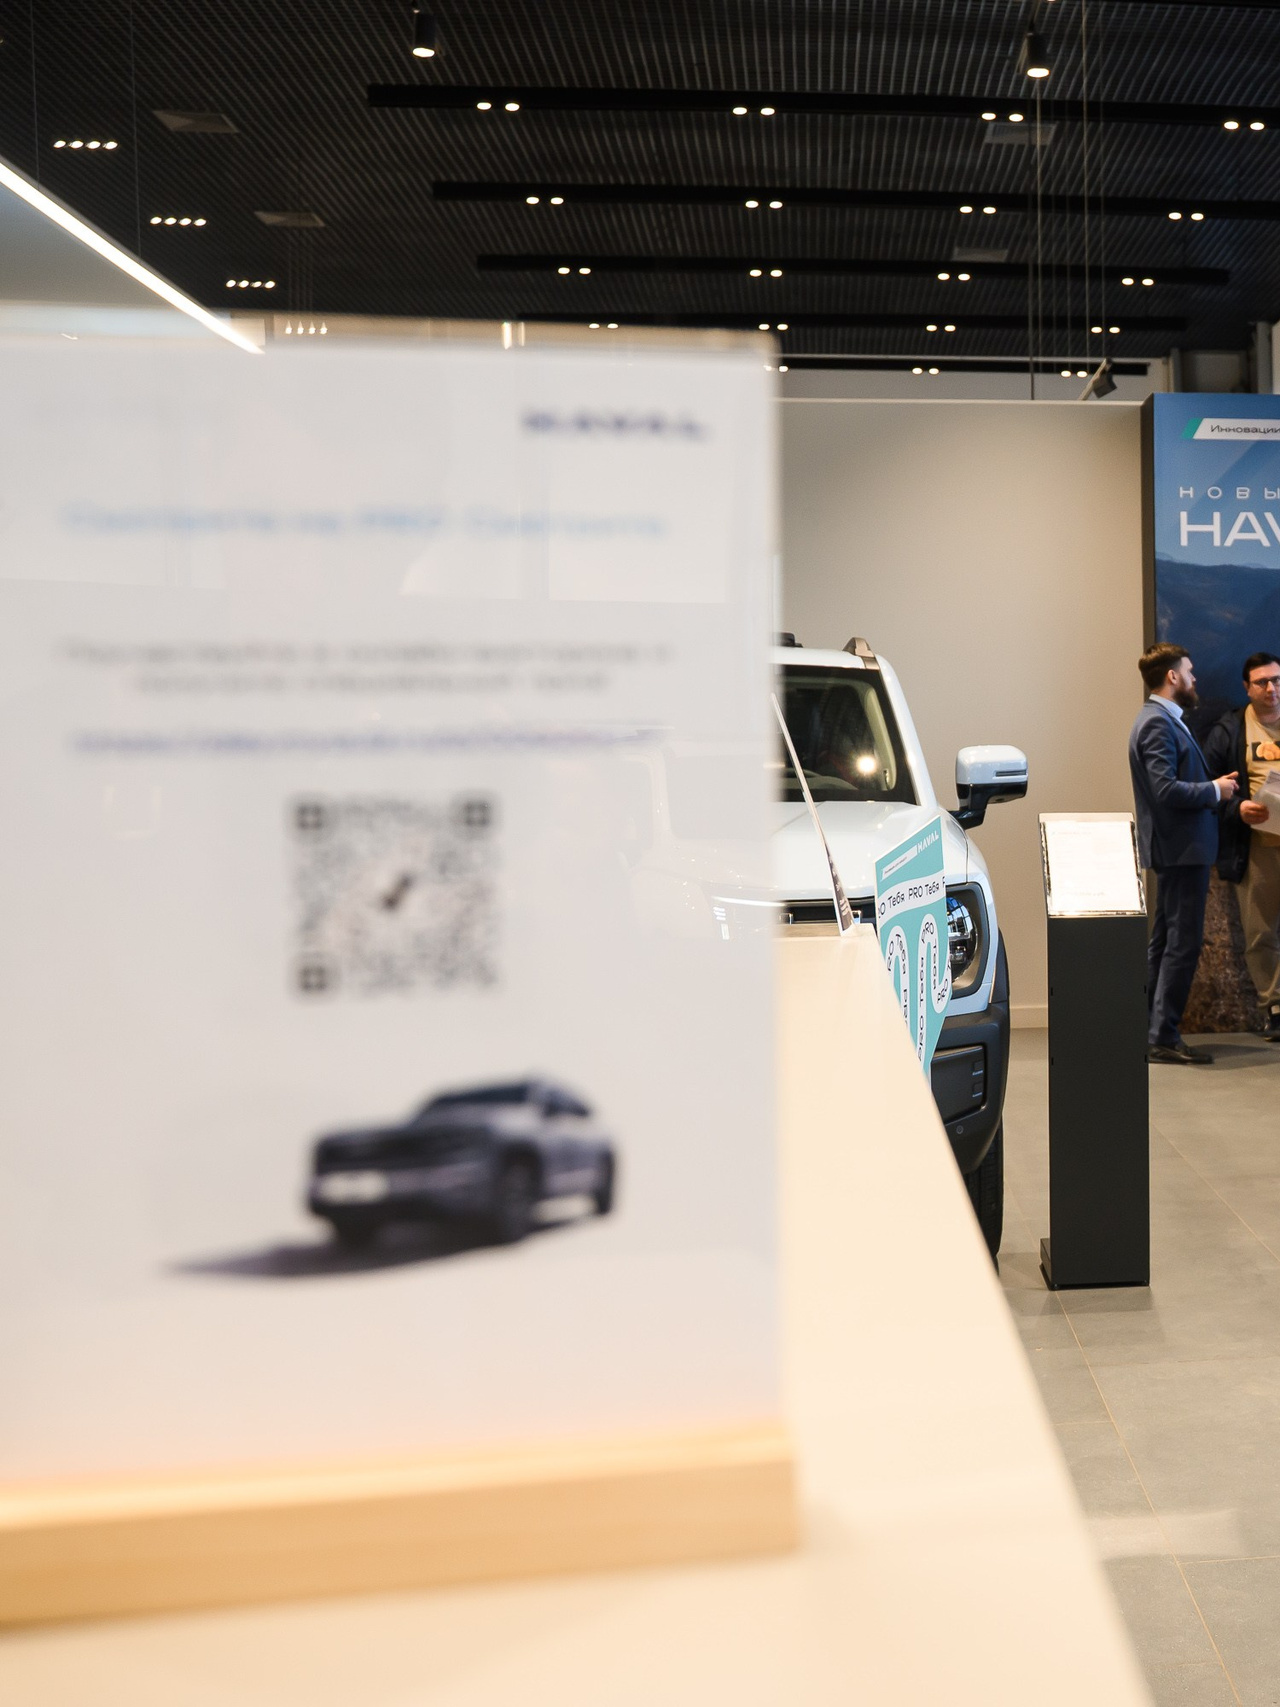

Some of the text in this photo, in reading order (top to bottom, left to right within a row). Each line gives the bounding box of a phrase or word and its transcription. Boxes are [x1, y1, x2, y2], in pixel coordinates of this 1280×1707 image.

[917, 830, 939, 853] HAVAL
[887, 891, 905, 909] Тебя
[908, 885, 924, 900] PRO
[925, 881, 940, 896] Тебя
